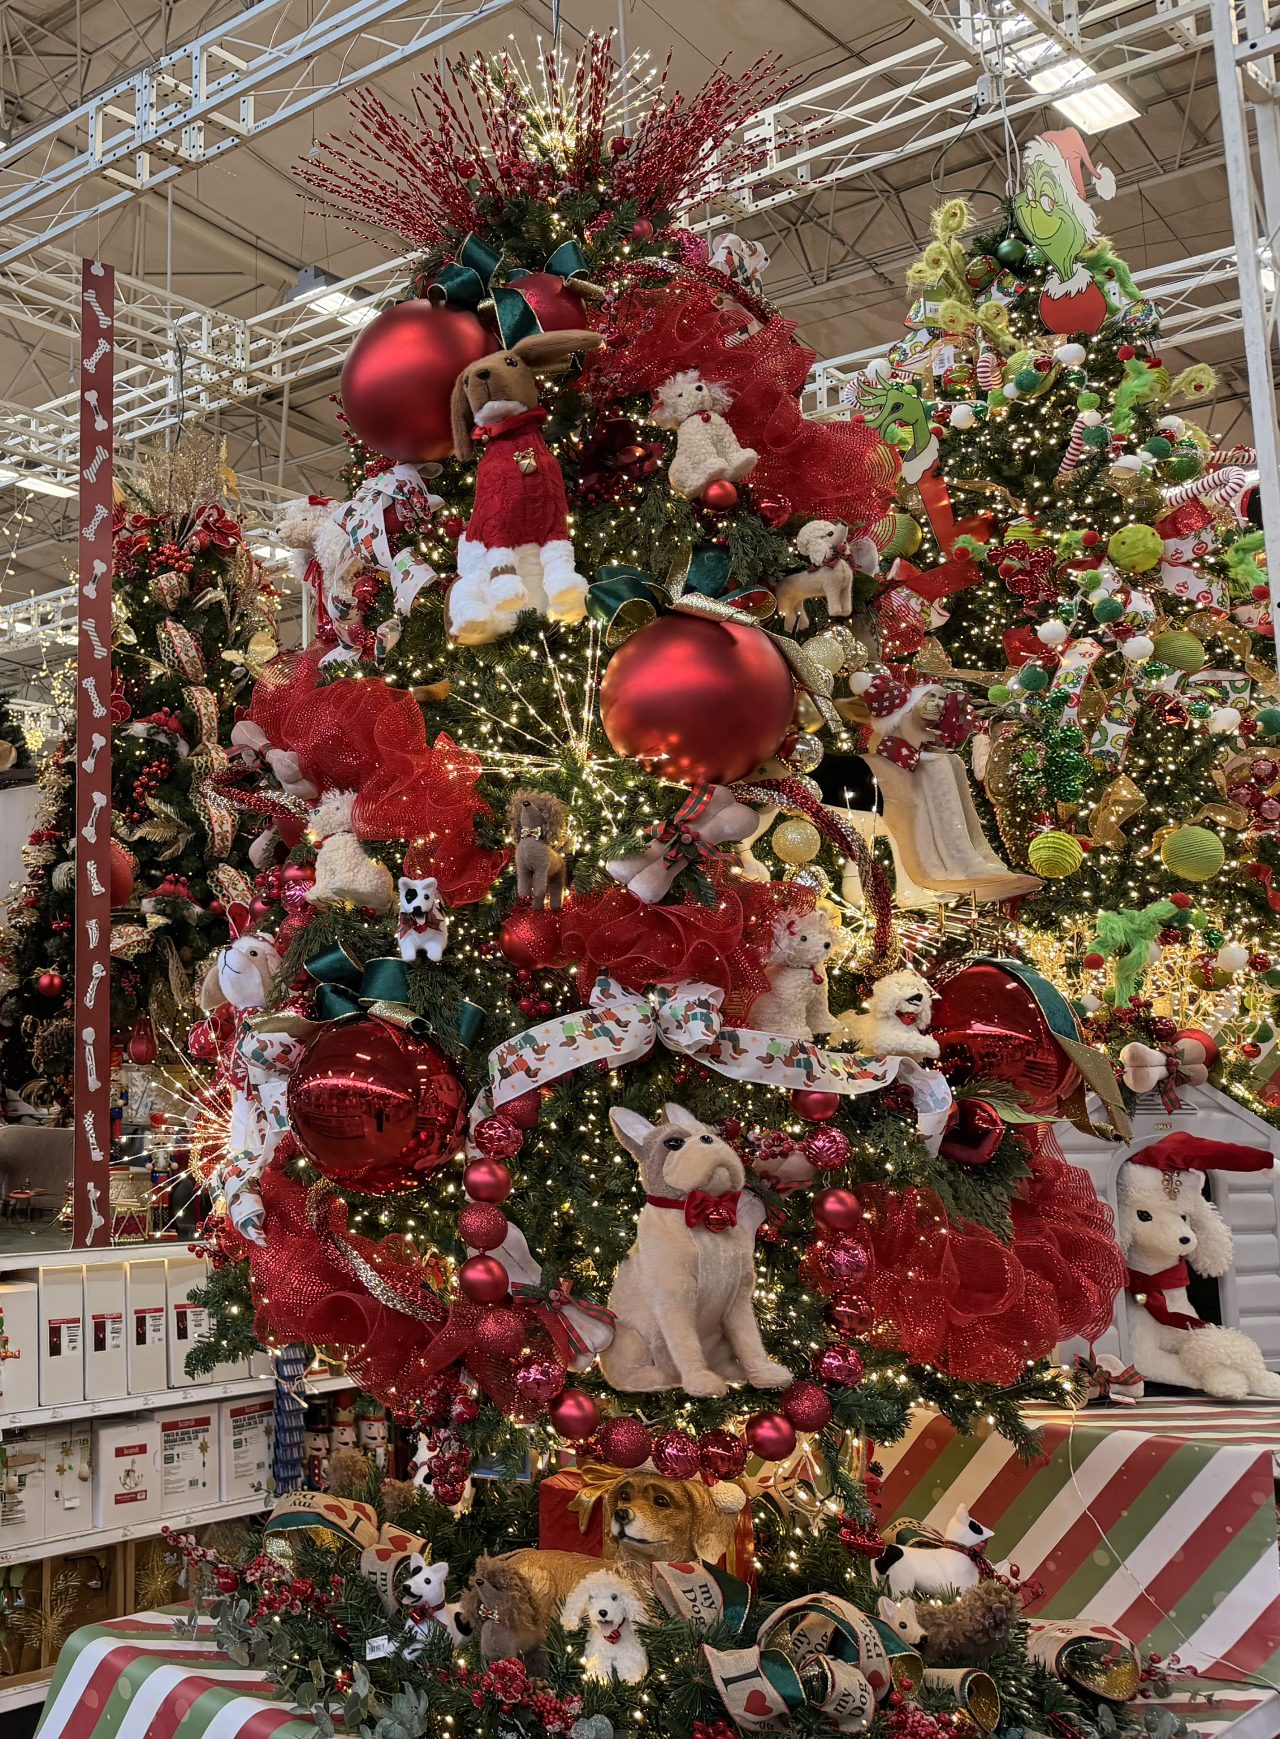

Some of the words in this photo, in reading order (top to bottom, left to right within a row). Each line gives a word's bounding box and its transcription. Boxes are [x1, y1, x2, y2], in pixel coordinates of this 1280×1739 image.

[290, 1500, 312, 1508] my
[380, 1572, 389, 1598] my
[698, 1583, 718, 1610] my
[681, 1586, 707, 1628] Dog
[860, 1630, 874, 1660] my
[720, 1667, 763, 1693] I
[832, 1687, 856, 1715] my
[848, 1679, 871, 1719] Dog
